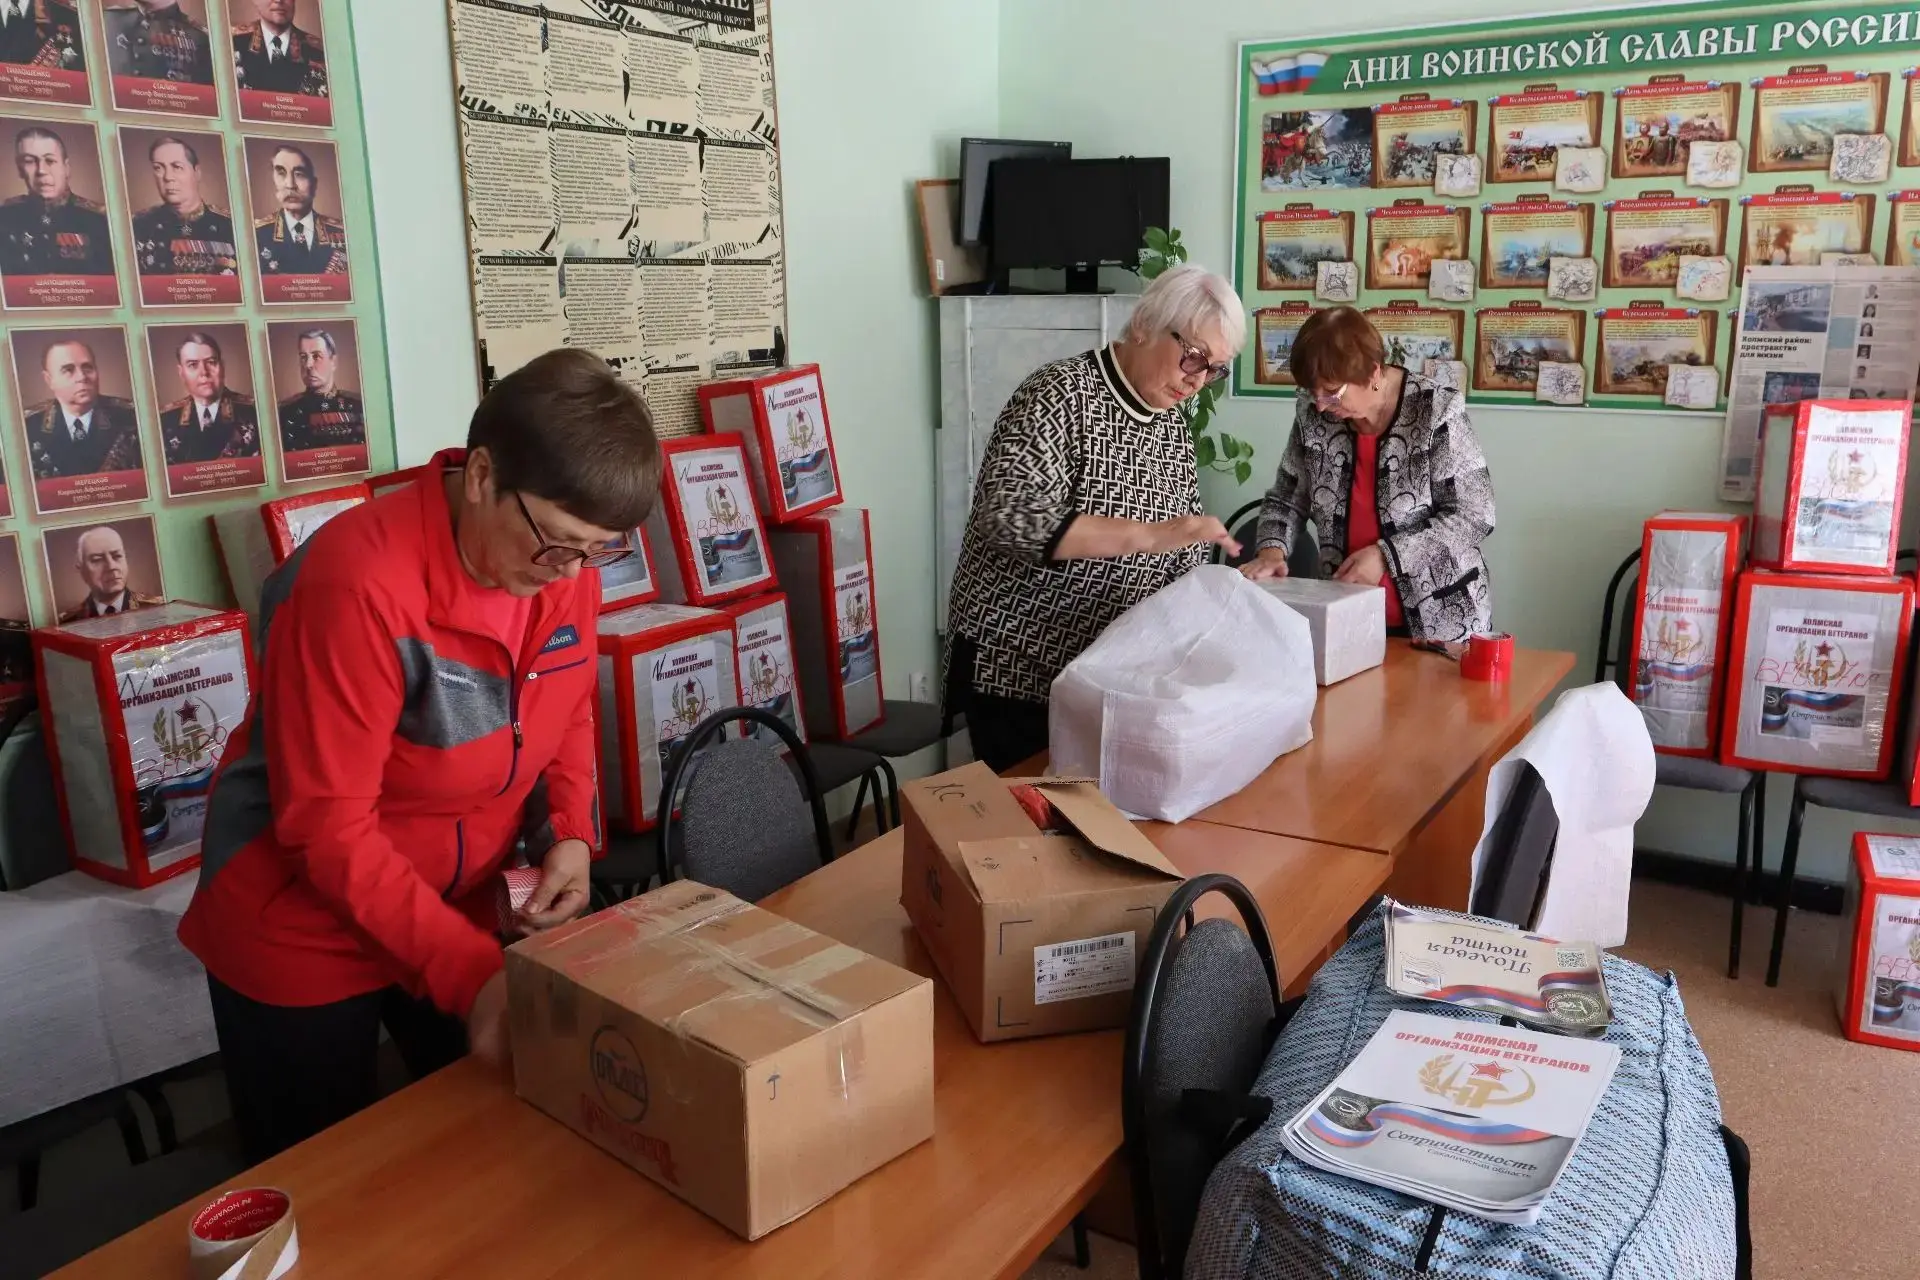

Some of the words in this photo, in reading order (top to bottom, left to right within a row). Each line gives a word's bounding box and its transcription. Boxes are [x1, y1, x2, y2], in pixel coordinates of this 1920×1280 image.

[1343, 54, 1412, 90] ДНИ
[1420, 31, 1611, 78] ВОИНСКОЙ
[1619, 24, 1759, 63] СЛАВЫ
[1741, 343, 1798, 352] пространство
[1742, 335, 1783, 344] Холмский
[1784, 335, 1812, 345] район:
[1756, 351, 1784, 359] жизни
[1776, 624, 1827, 636] ОРГАНИЗАЦИЯ
[1828, 629, 1869, 640] ВЕТЕРАНОВ
[1802, 617, 1843, 628] ХОЛМСКАЯ
[152, 667, 201, 688] ХОЛМСКАЯ
[120, 685, 186, 710] ОРГАНИЗАЦИЯ
[185, 672, 234, 694] ВЕТЕРАНОВ
[1426, 941, 1532, 975] Полевая
[1450, 935, 1528, 959] почта
[1395, 1031, 1500, 1058] ОРГАНИЗАЦИЯ
[1501, 1051, 1591, 1073] ВЕТЕРАНОВ
[1453, 1031, 1538, 1053] ХОЛМСКАЯ
[1387, 1129, 1538, 1171] Сопричастность
[203, 1202, 240, 1230] NOVAROLL
